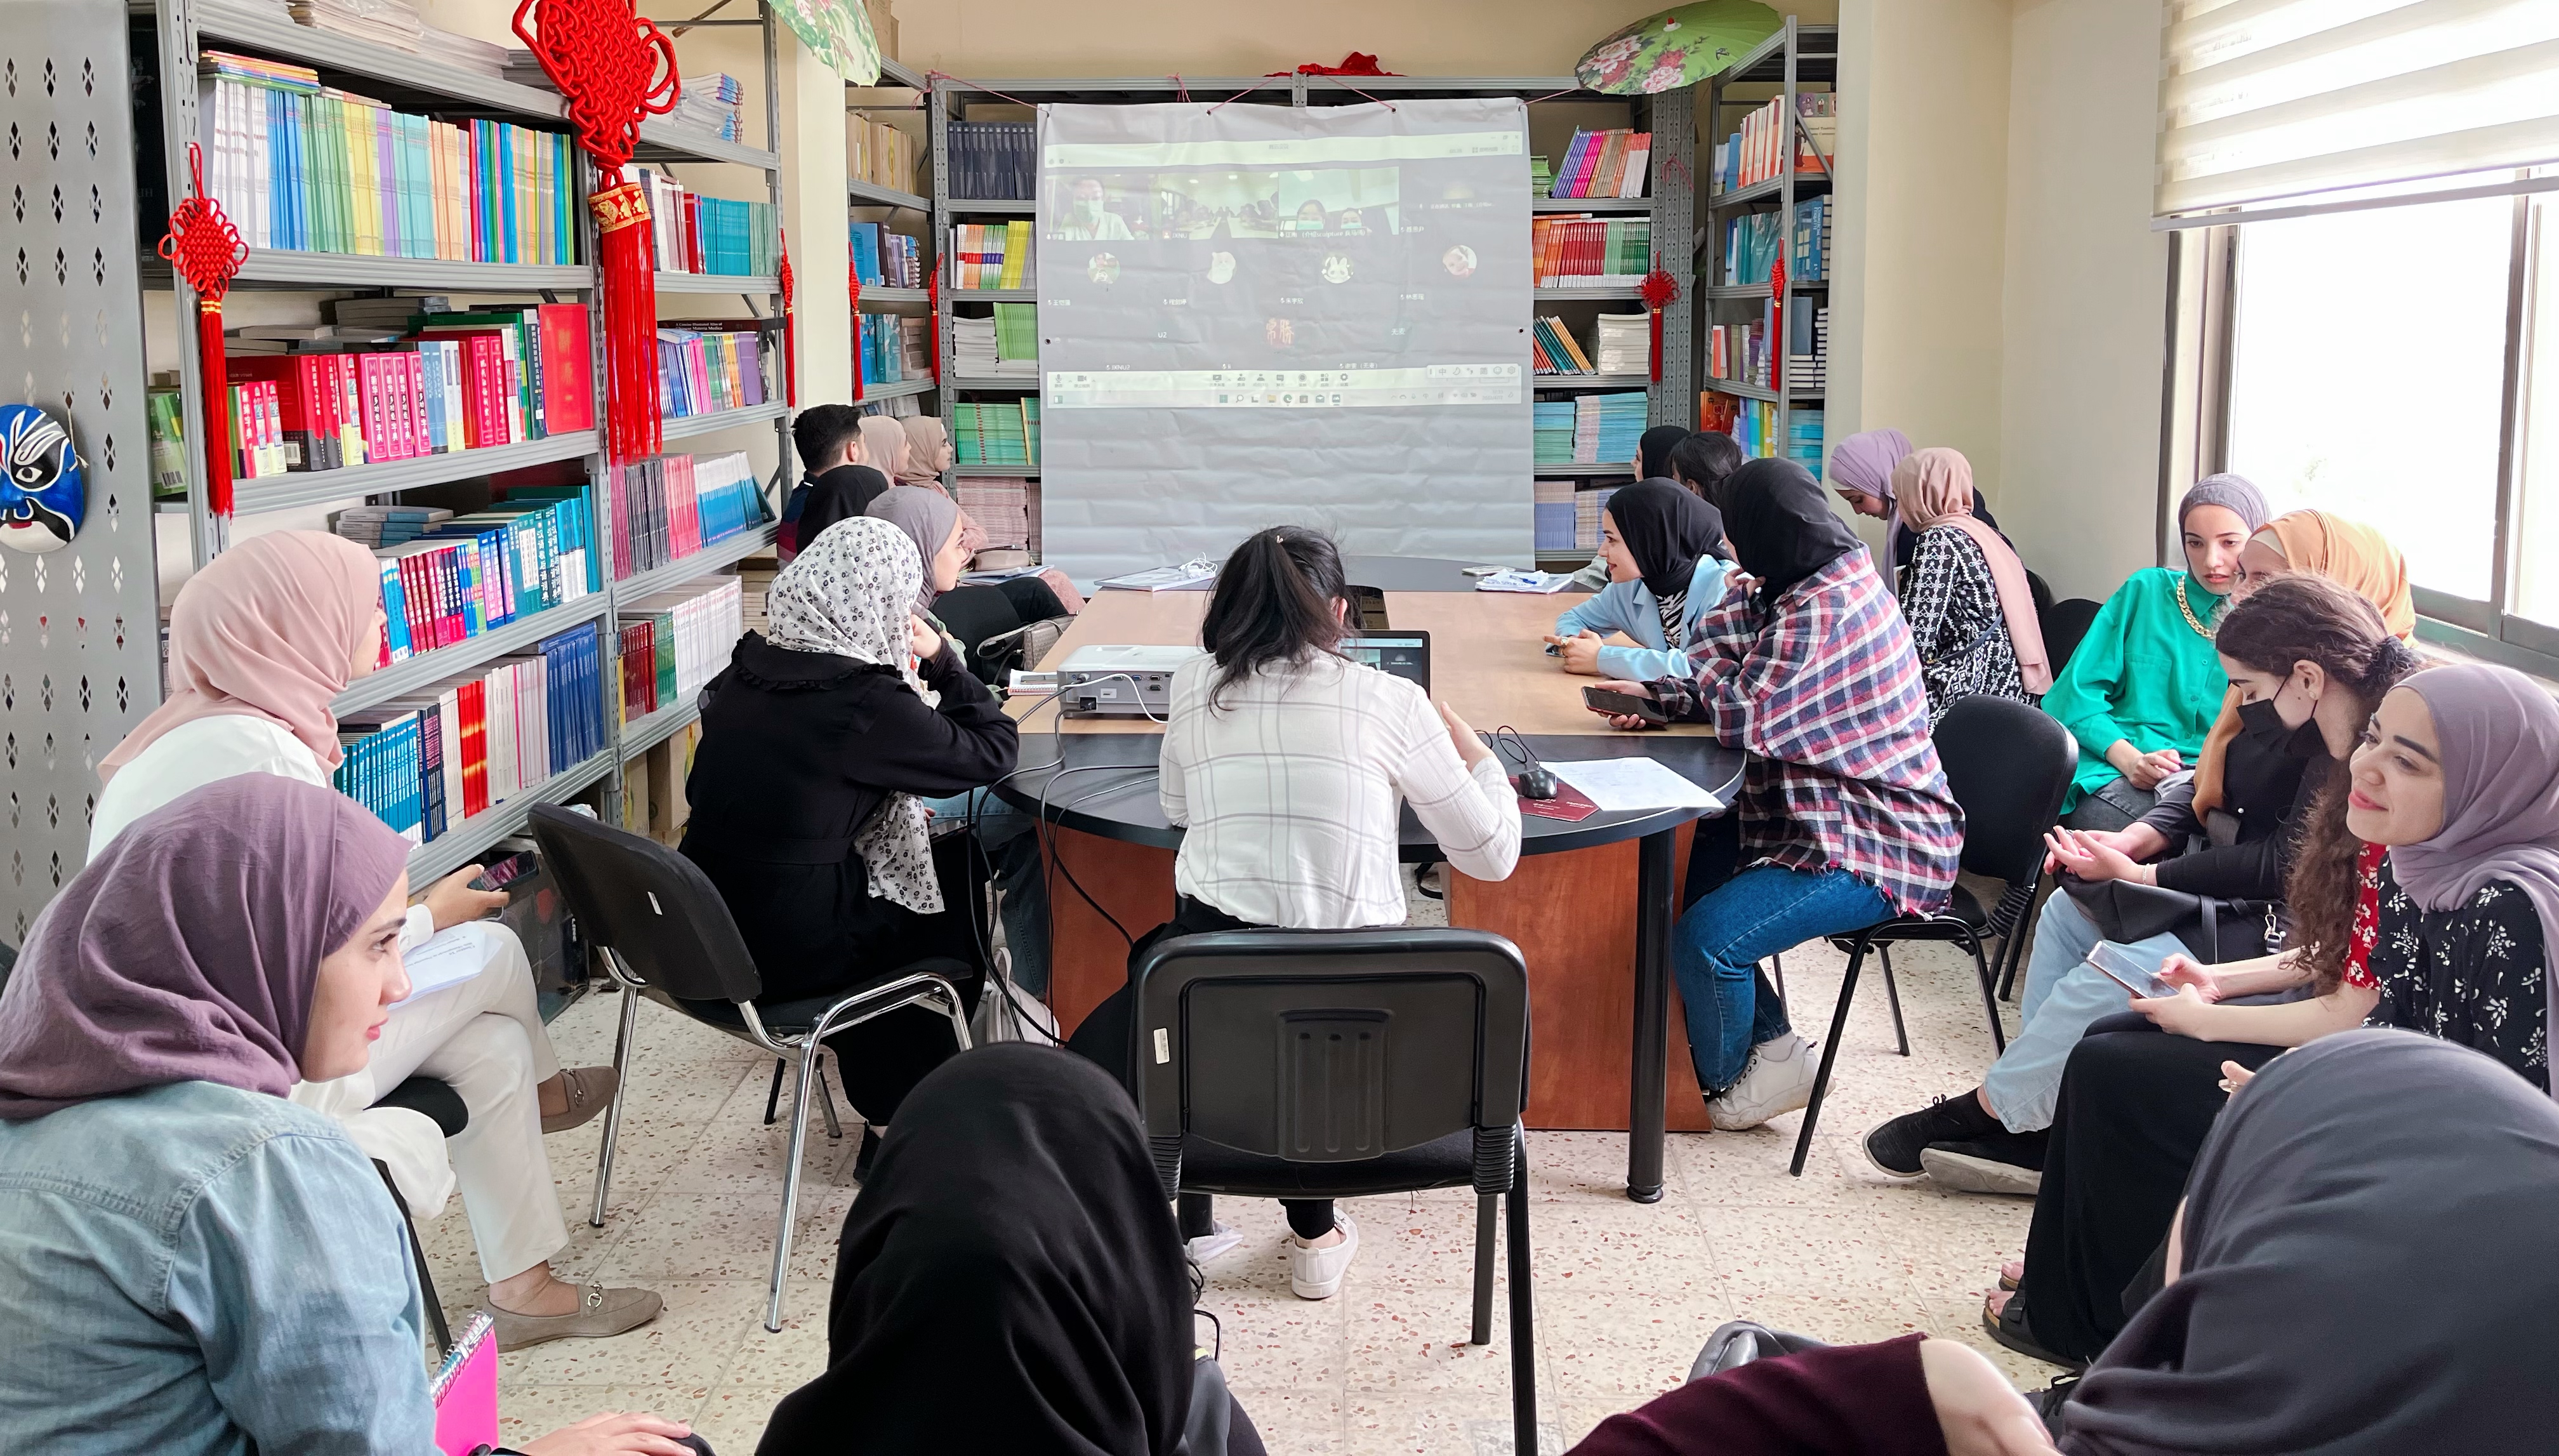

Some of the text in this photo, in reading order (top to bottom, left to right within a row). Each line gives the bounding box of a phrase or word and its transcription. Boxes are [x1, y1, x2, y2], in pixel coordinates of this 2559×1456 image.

[370, 375, 383, 443] 新华多功能字典
[385, 374, 399, 442] 新华多功能字典
[399, 374, 412, 440] 新华多功能字典
[416, 372, 428, 437] 新华多功能字典
